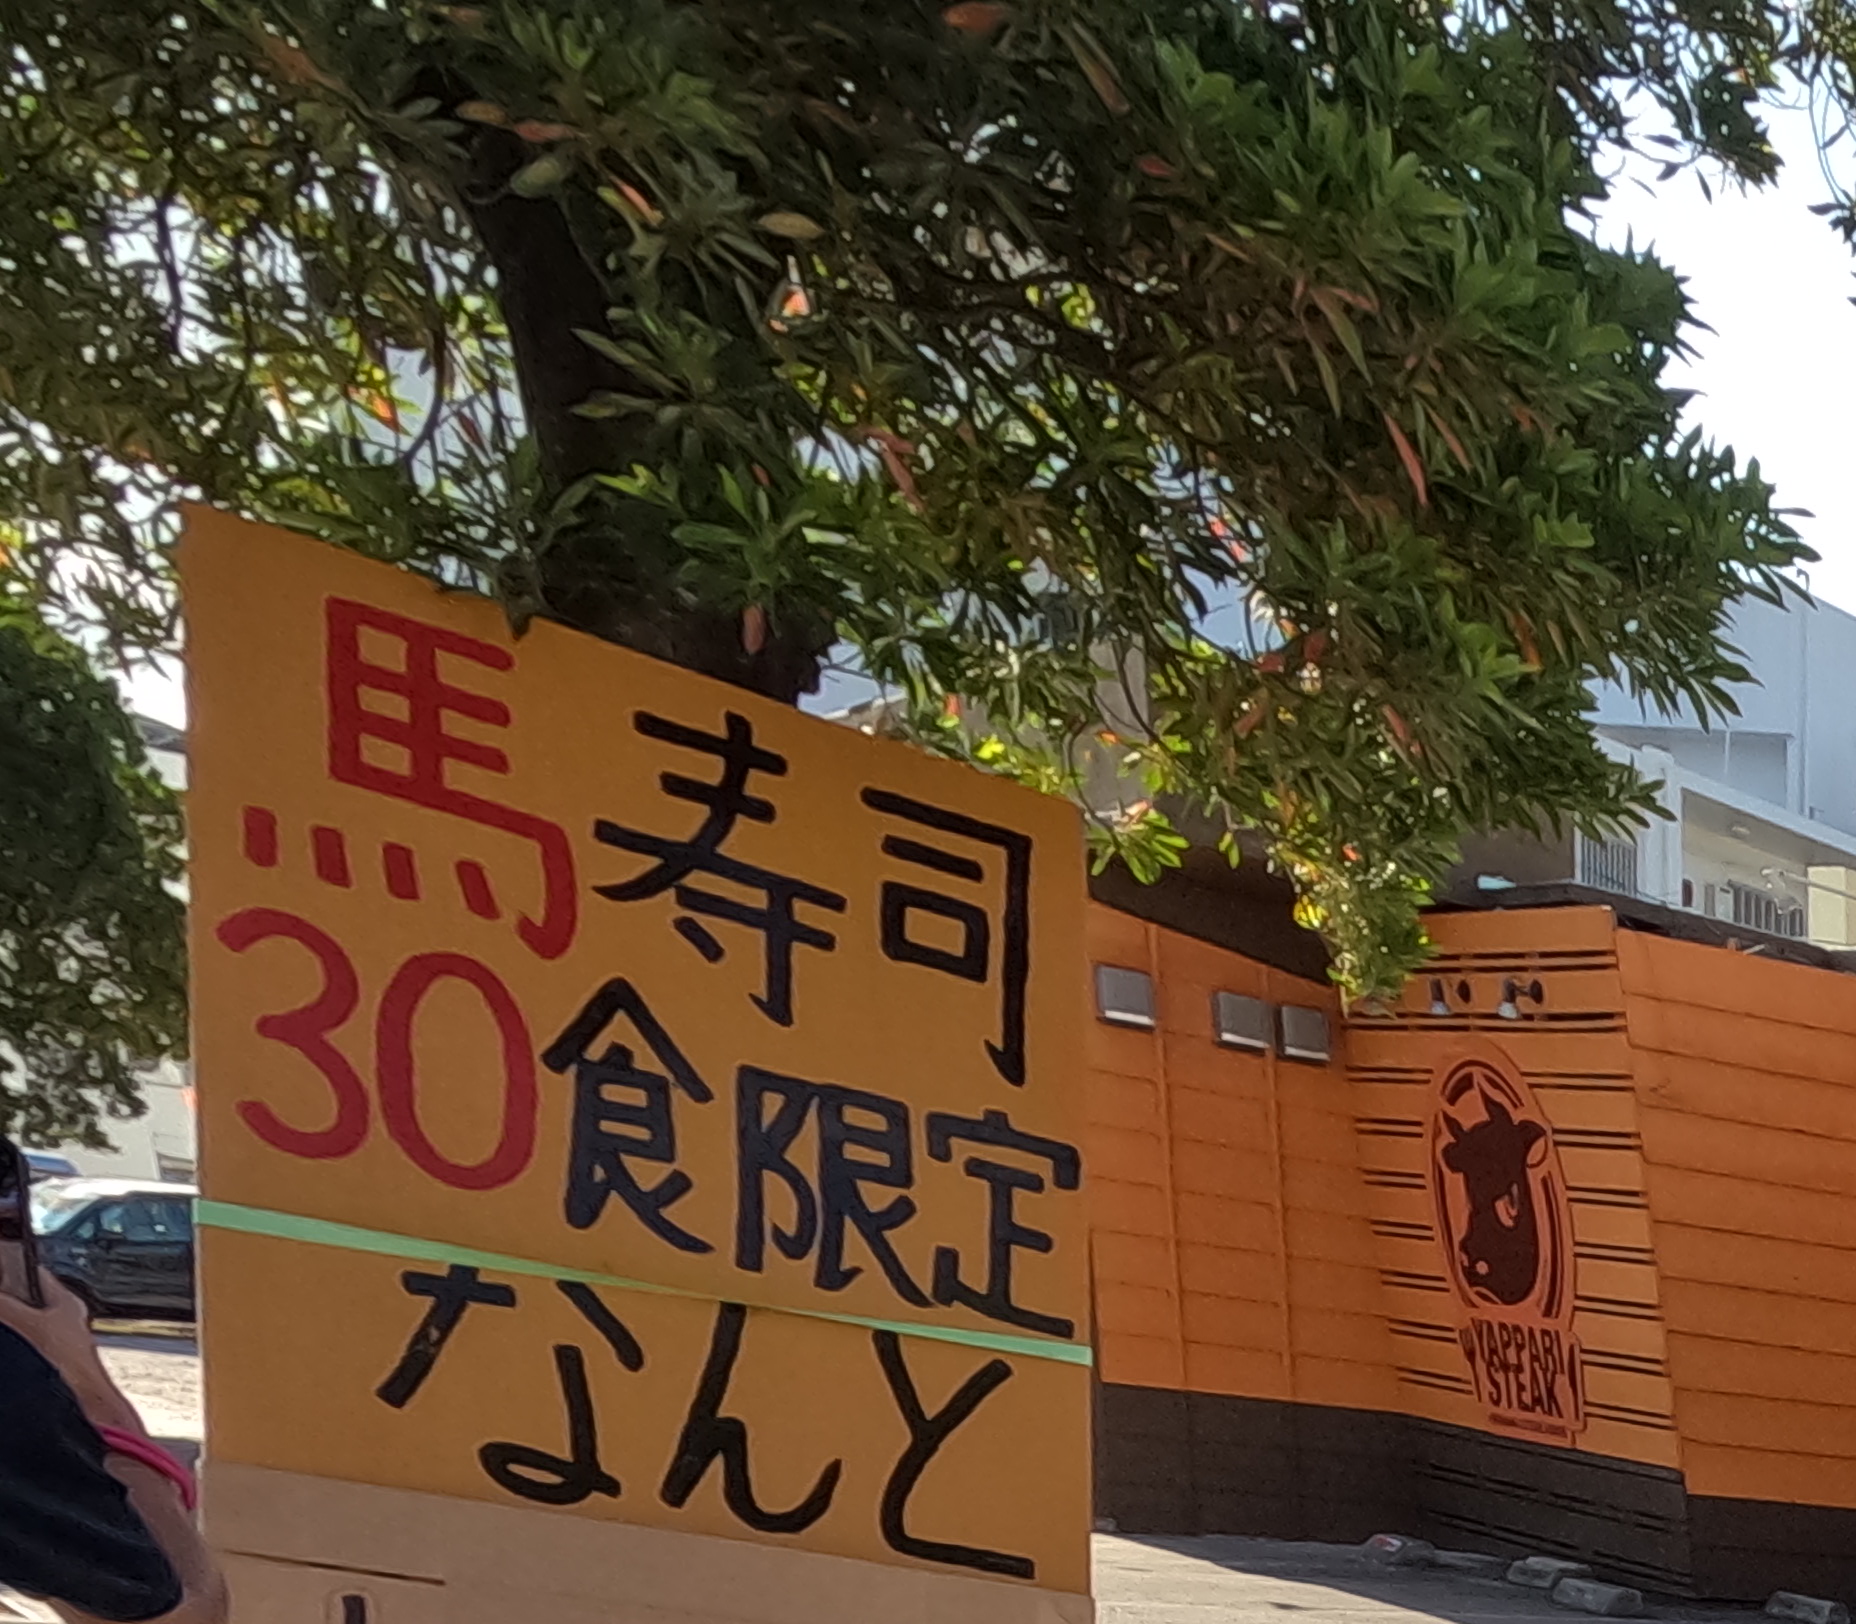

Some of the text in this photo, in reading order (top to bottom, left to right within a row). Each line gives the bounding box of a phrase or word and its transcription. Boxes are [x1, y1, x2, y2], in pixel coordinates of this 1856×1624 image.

[242, 596, 1030, 1085] 馬寿司
[215, 908, 1083, 1337] 30食限定
[375, 1263, 1036, 1579] なんと
[1471, 1317, 1565, 1374] YAPPARI
[1486, 1361, 1563, 1418] STEAK
